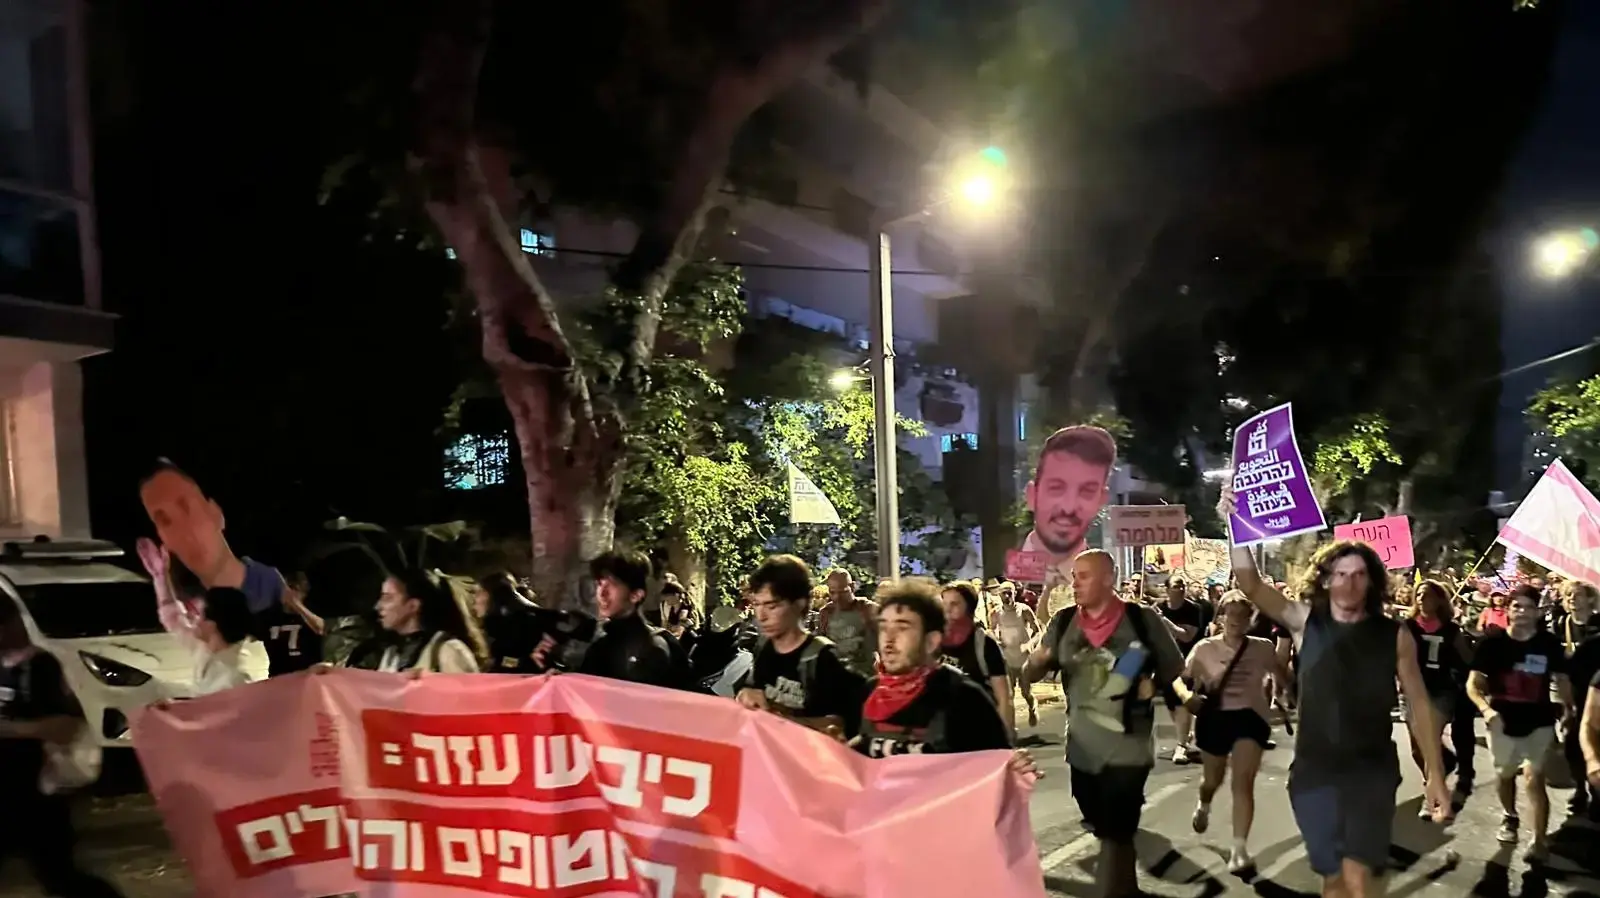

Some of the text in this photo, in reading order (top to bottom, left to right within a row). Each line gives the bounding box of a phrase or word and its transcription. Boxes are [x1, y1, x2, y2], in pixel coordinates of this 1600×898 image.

[1235, 463, 1291, 489] להרעבה
[1252, 496, 1292, 513] בעזה
[533, 732, 712, 818] כיבש
